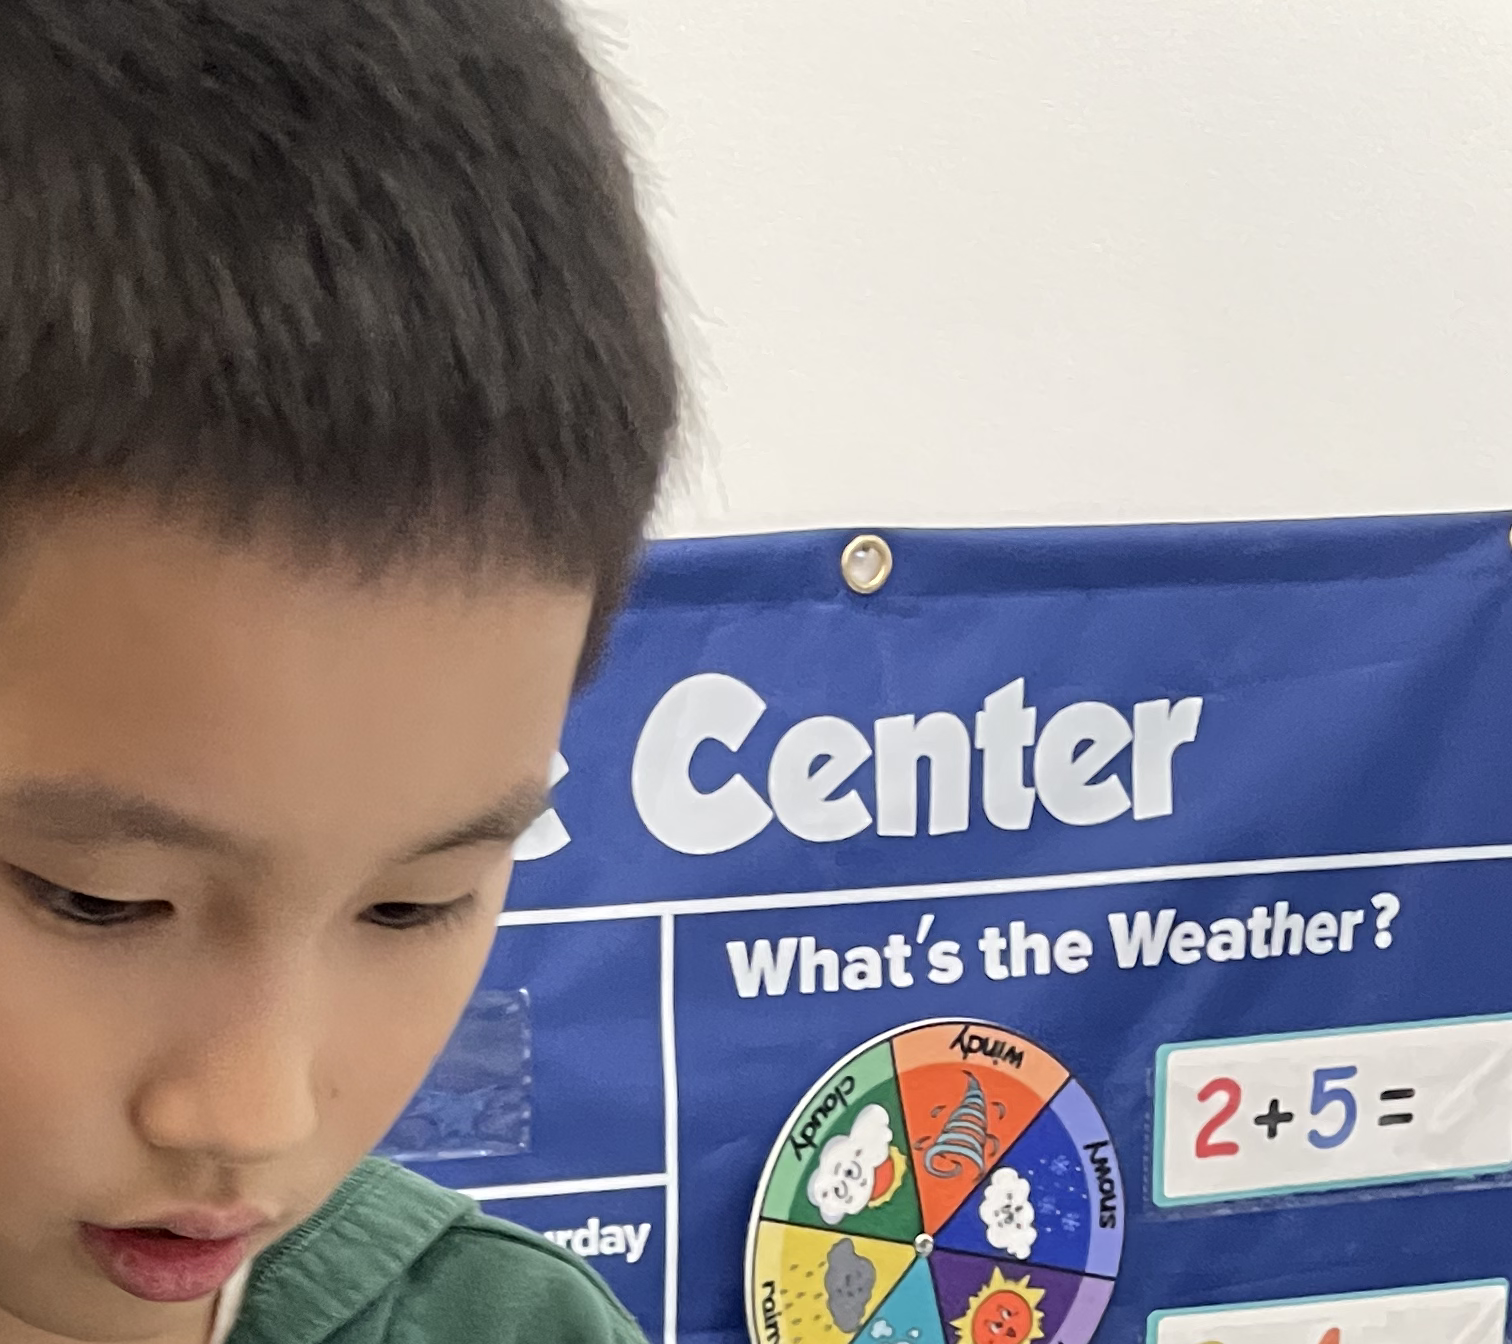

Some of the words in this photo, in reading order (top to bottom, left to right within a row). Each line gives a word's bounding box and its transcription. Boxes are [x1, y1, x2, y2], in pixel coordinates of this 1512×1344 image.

[632, 672, 1204, 856] Center
[726, 913, 963, 998] What's
[977, 922, 1091, 982] the
[1108, 893, 1402, 971] Weather?
[950, 1025, 1026, 1070] windy
[790, 1074, 856, 1161] cloudy
[1083, 1139, 1117, 1230] snowy
